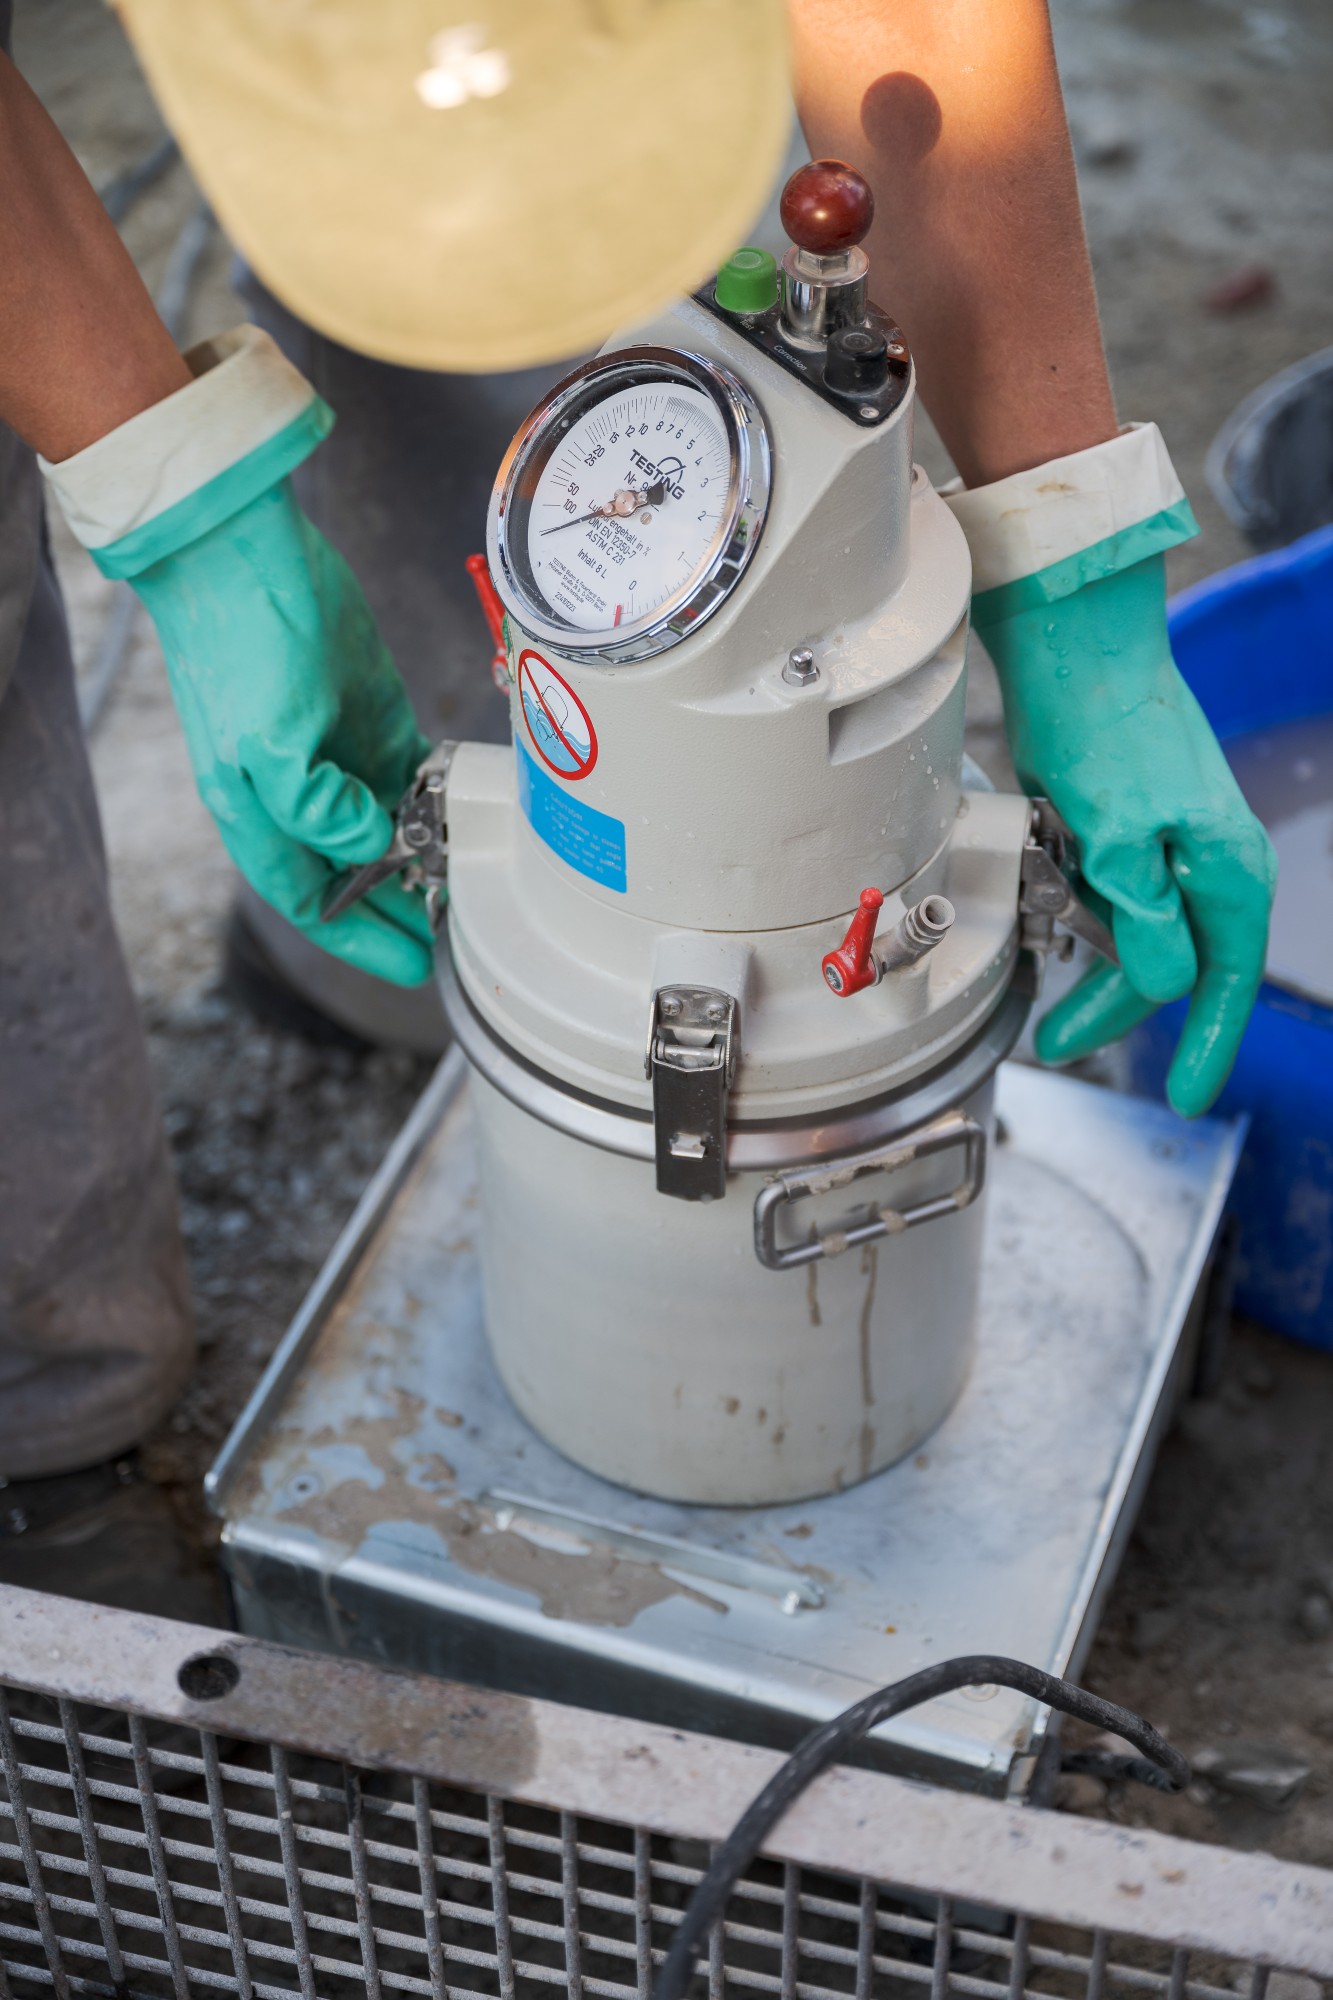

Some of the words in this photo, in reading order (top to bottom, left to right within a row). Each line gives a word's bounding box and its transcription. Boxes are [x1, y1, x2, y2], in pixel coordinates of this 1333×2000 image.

[774, 345, 808, 370] Correction
[625, 425, 636, 438] 12
[638, 423, 648, 436] 10
[656, 420, 664, 431] 8
[666, 424, 674, 434] 7
[608, 432, 620, 444] 15
[676, 428, 684, 438] 6
[686, 439, 696, 450] 5
[592, 444, 605, 458] 20
[584, 454, 597, 466] 25
[694, 456, 703, 466] 4
[624, 470, 636, 488] Nr.
[630, 448, 685, 500] TESTING
[568, 482, 580, 496] 50
[700, 478, 708, 488] 3
[563, 498, 577, 514] 100
[698, 510, 706, 521] 2
[586, 530, 608, 550] ASTM
[606, 546, 614, 556] C
[612, 552, 626, 566] 231
[600, 526, 612, 540] EN
[611, 535, 636, 558] 12350-7
[636, 540, 644, 551] in
[678, 551, 685, 560] 1
[578, 548, 596, 568] Inhalt
[596, 564, 602, 573] 8
[600, 568, 608, 578] L
[628, 580, 637, 590] 0
